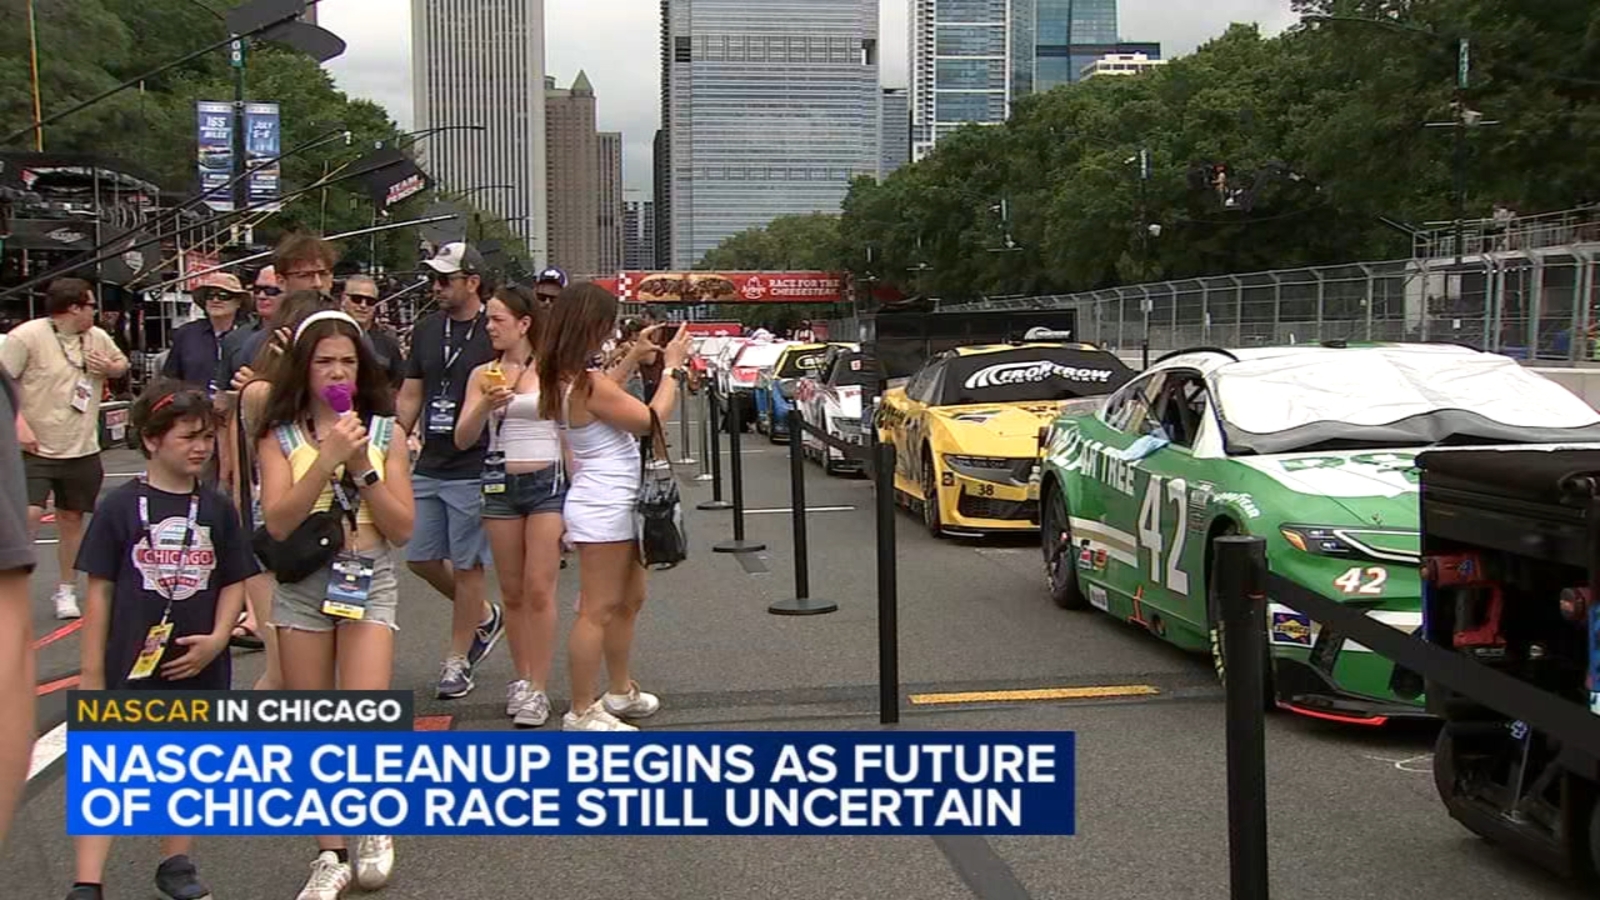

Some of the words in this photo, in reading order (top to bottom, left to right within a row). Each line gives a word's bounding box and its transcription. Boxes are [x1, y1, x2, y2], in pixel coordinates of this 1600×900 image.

[769, 279, 796, 287] RACE
[799, 279, 818, 287] FOR
[979, 485, 994, 496] 38
[1138, 474, 1188, 596] 42
[1333, 566, 1388, 595] 42
